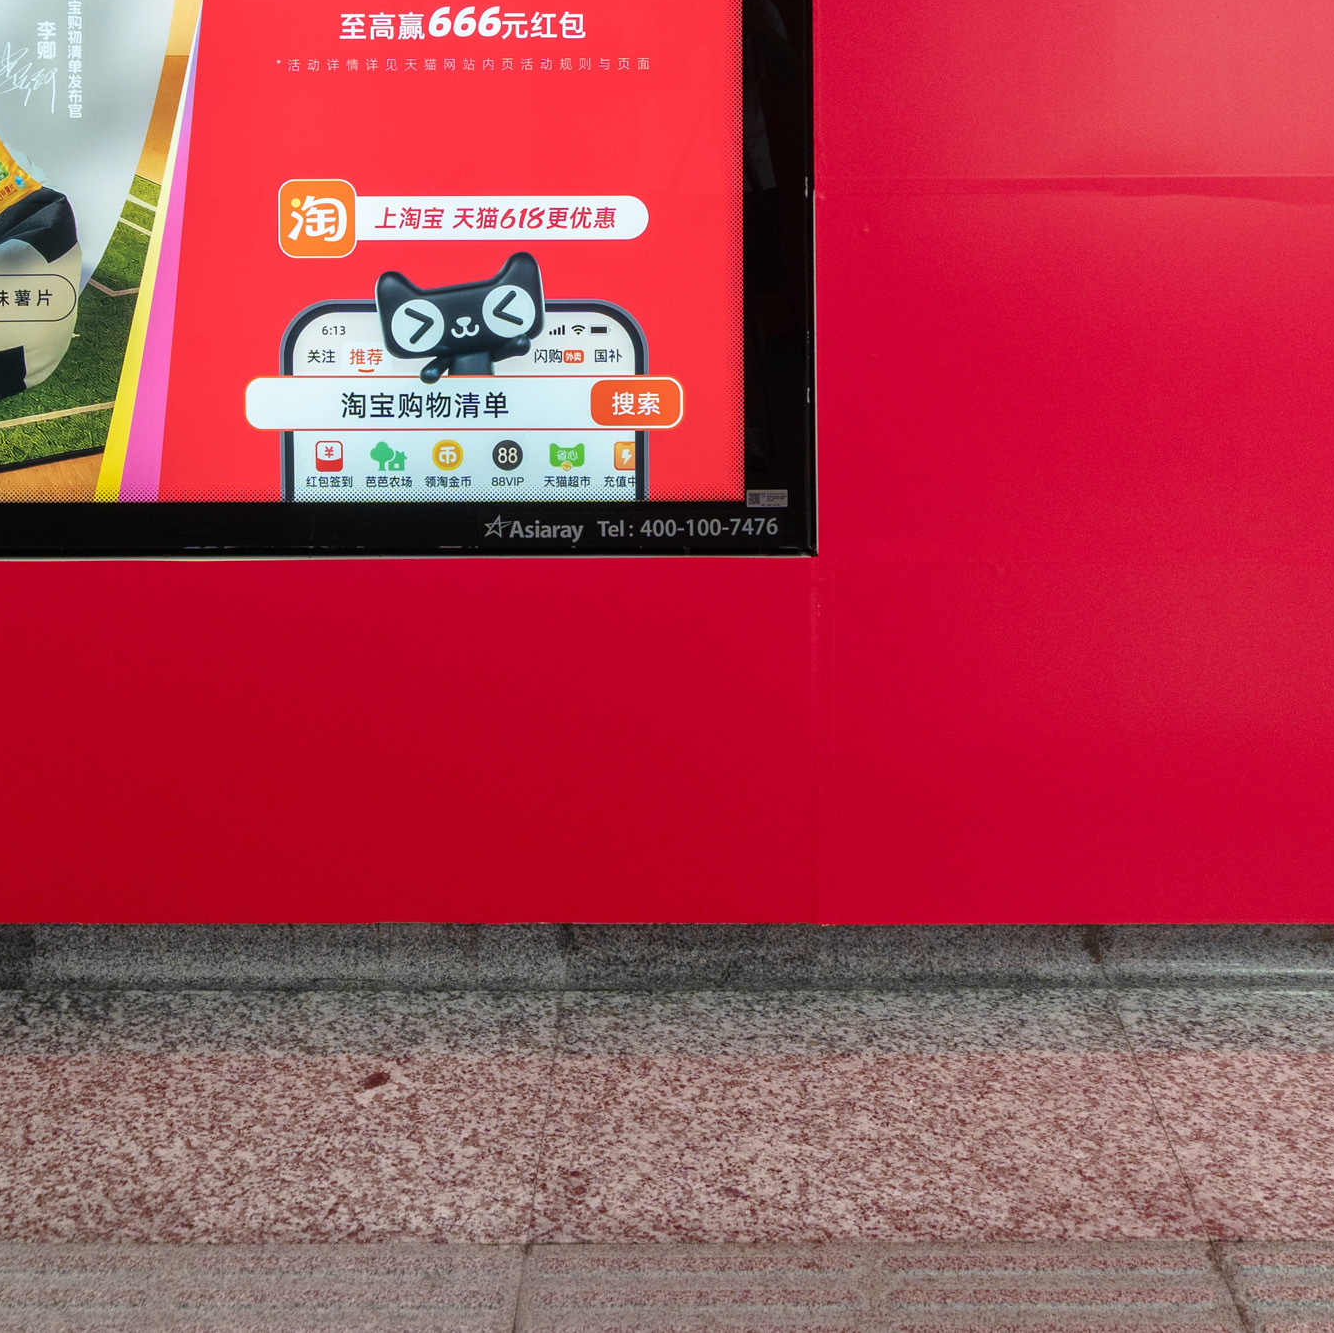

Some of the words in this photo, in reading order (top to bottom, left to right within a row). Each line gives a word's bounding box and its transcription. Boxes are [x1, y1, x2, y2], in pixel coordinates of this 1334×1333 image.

[340, 6, 586, 40] 至高赢666元红包
[288, 196, 347, 241] 淘
[375, 207, 444, 229] 上淘宝
[453, 207, 616, 229] 天猫618更优惠
[322, 326, 345, 335] 6:13
[308, 350, 335, 363] 关注
[351, 349, 382, 365] 推荐
[535, 349, 562, 363] 闪购
[565, 351, 582, 362] 外卖
[595, 349, 622, 362] 国补
[342, 392, 508, 418] 淘宝购物清单
[612, 392, 660, 415] 搜索
[439, 447, 456, 464] 币
[498, 447, 517, 463] 88
[306, 476, 352, 488] 红包签到
[366, 476, 412, 488] 芭芭农场
[425, 476, 471, 488] 领淘金币
[492, 477, 524, 486] 88VIP
[544, 476, 591, 488] 天猫超市
[509, 520, 584, 543] Asiaray
[640, 518, 778, 536] 400-100-7476
